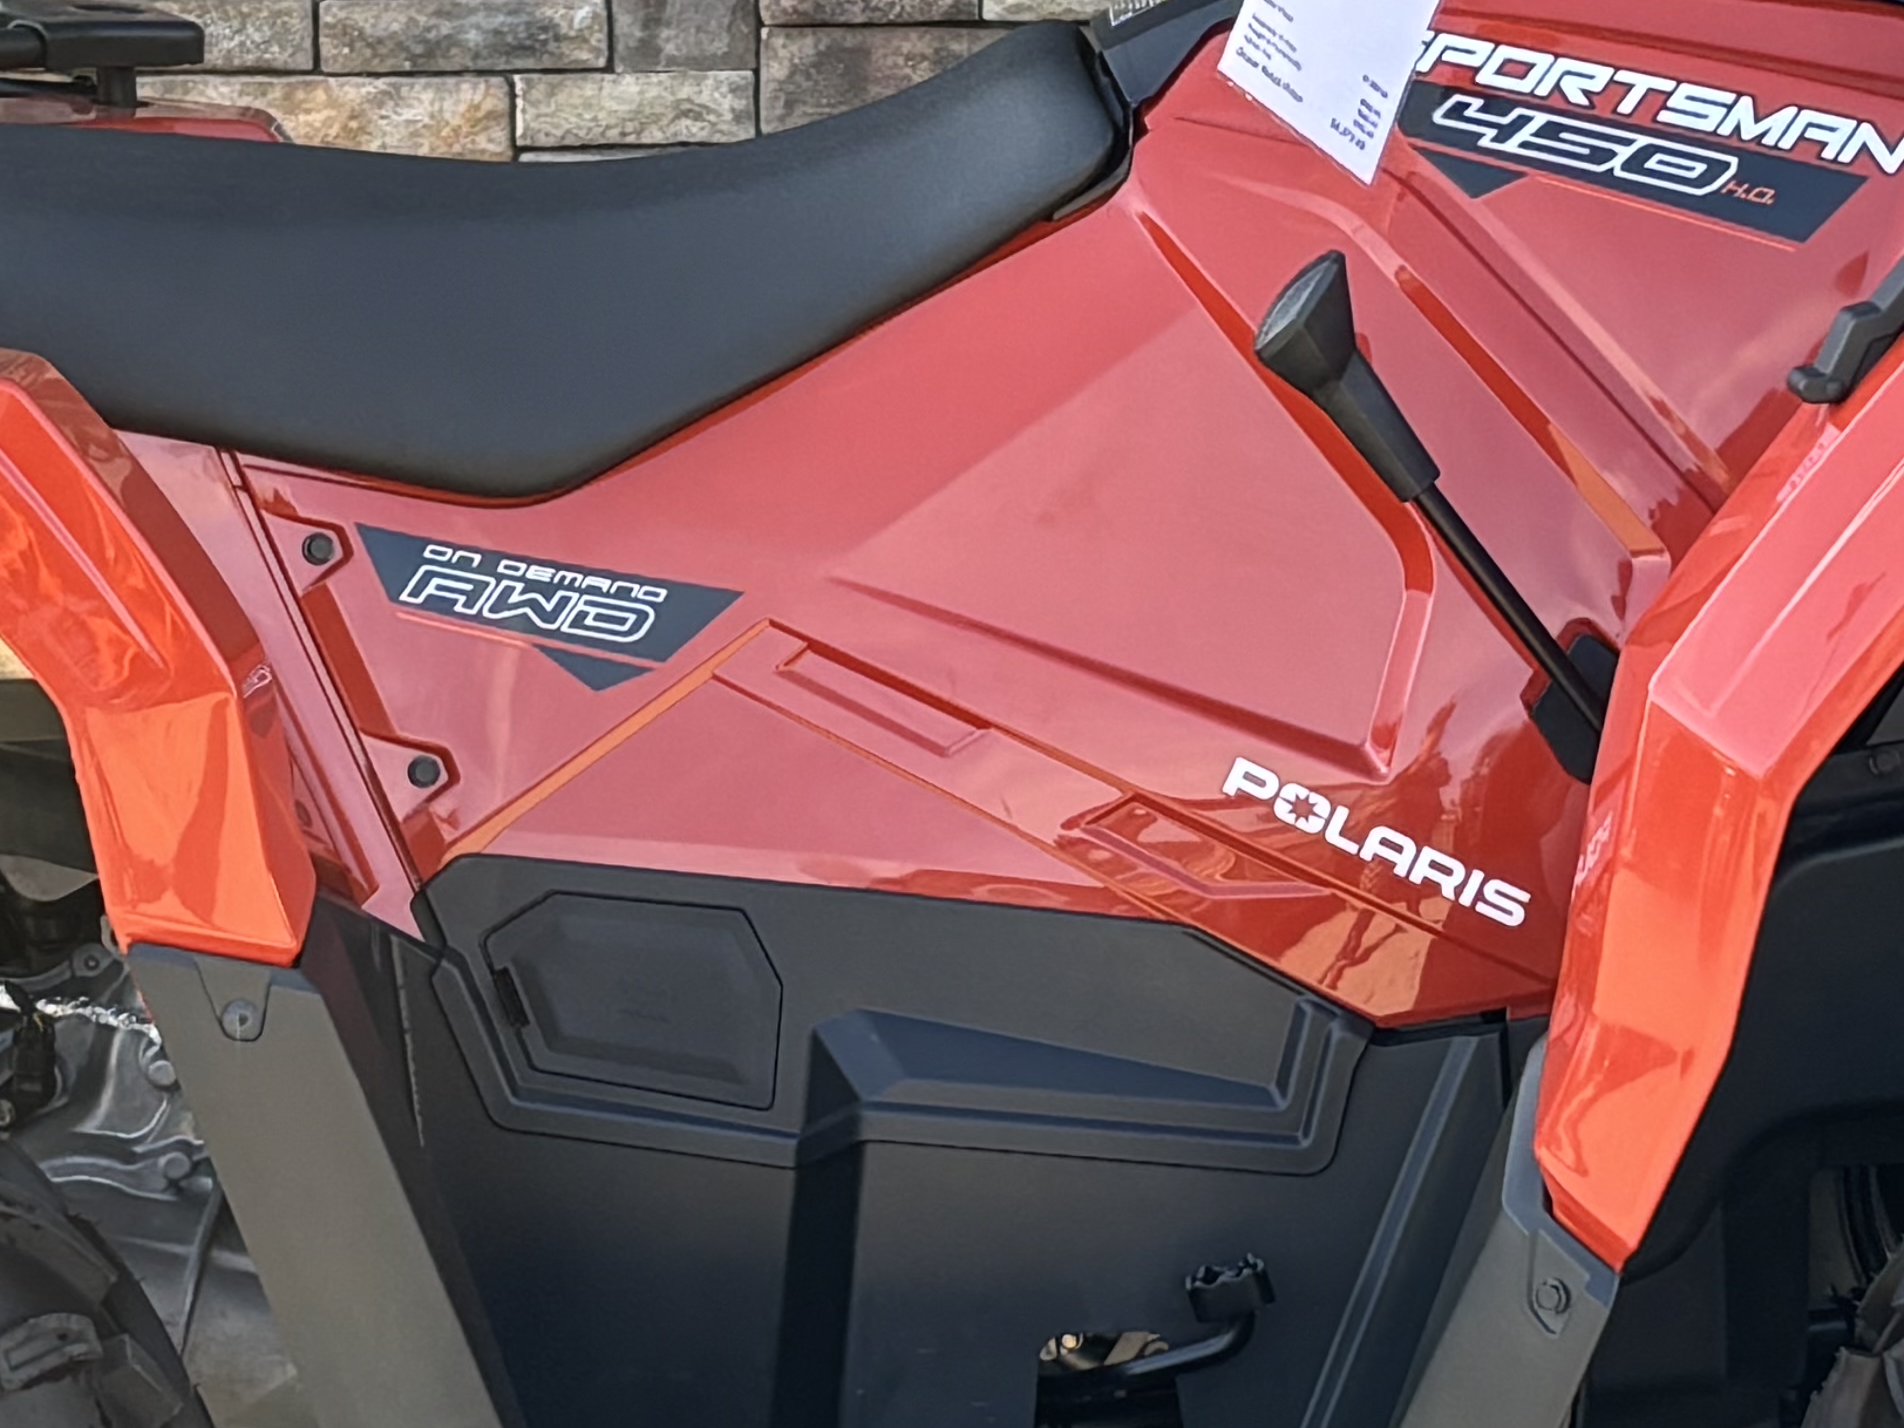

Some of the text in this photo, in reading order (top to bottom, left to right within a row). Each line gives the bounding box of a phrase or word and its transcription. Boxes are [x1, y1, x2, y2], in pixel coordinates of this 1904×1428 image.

[1432, 93, 1739, 196] 450
[1720, 180, 1776, 205] H.O.
[398, 564, 656, 644] AWD
[423, 544, 669, 603] ON DEMAND
[1222, 756, 1532, 928] POLARIS
